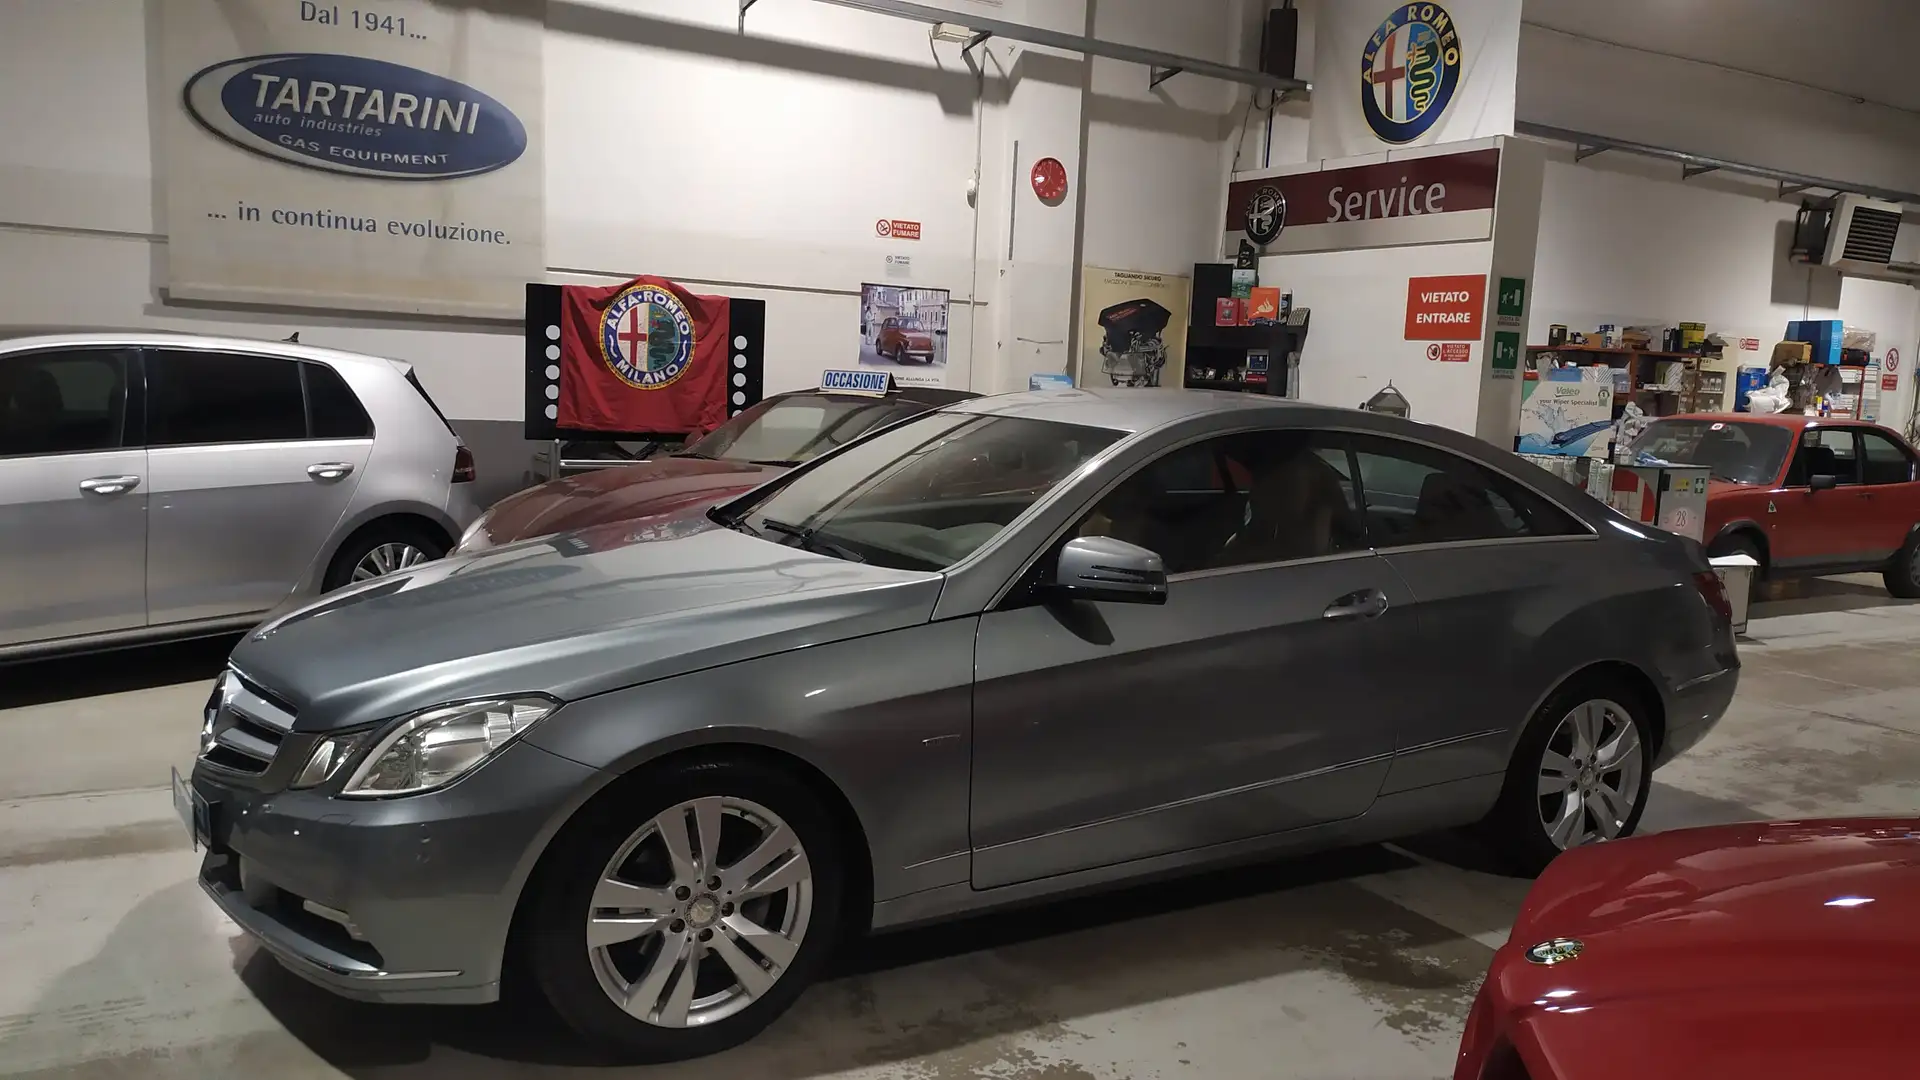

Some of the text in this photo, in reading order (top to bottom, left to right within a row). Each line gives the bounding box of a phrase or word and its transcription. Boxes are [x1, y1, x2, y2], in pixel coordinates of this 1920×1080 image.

[301, 2, 428, 40] Dal 1941...
[1363, 5, 1459, 84] ALFA ROMEO
[251, 73, 480, 135] TARTARINI
[253, 112, 382, 138] auto industries
[278, 133, 449, 165] GAS EQUIPMENT
[1326, 176, 1446, 223] Service
[238, 201, 260, 222] in
[271, 207, 377, 233] continua
[387, 218, 511, 245] evoluzione.
[893, 222, 919, 230] VIETATO
[893, 229, 919, 238] FUMARE
[1421, 291, 1469, 303] VIETATO
[606, 291, 690, 335] ALFA ROMEO
[1416, 312, 1471, 323] ENTRARE
[616, 360, 678, 384] MILANO
[825, 372, 886, 390] OCCASIONE
[1556, 386, 1581, 397] Valeo
[1675, 510, 1687, 527] 28
